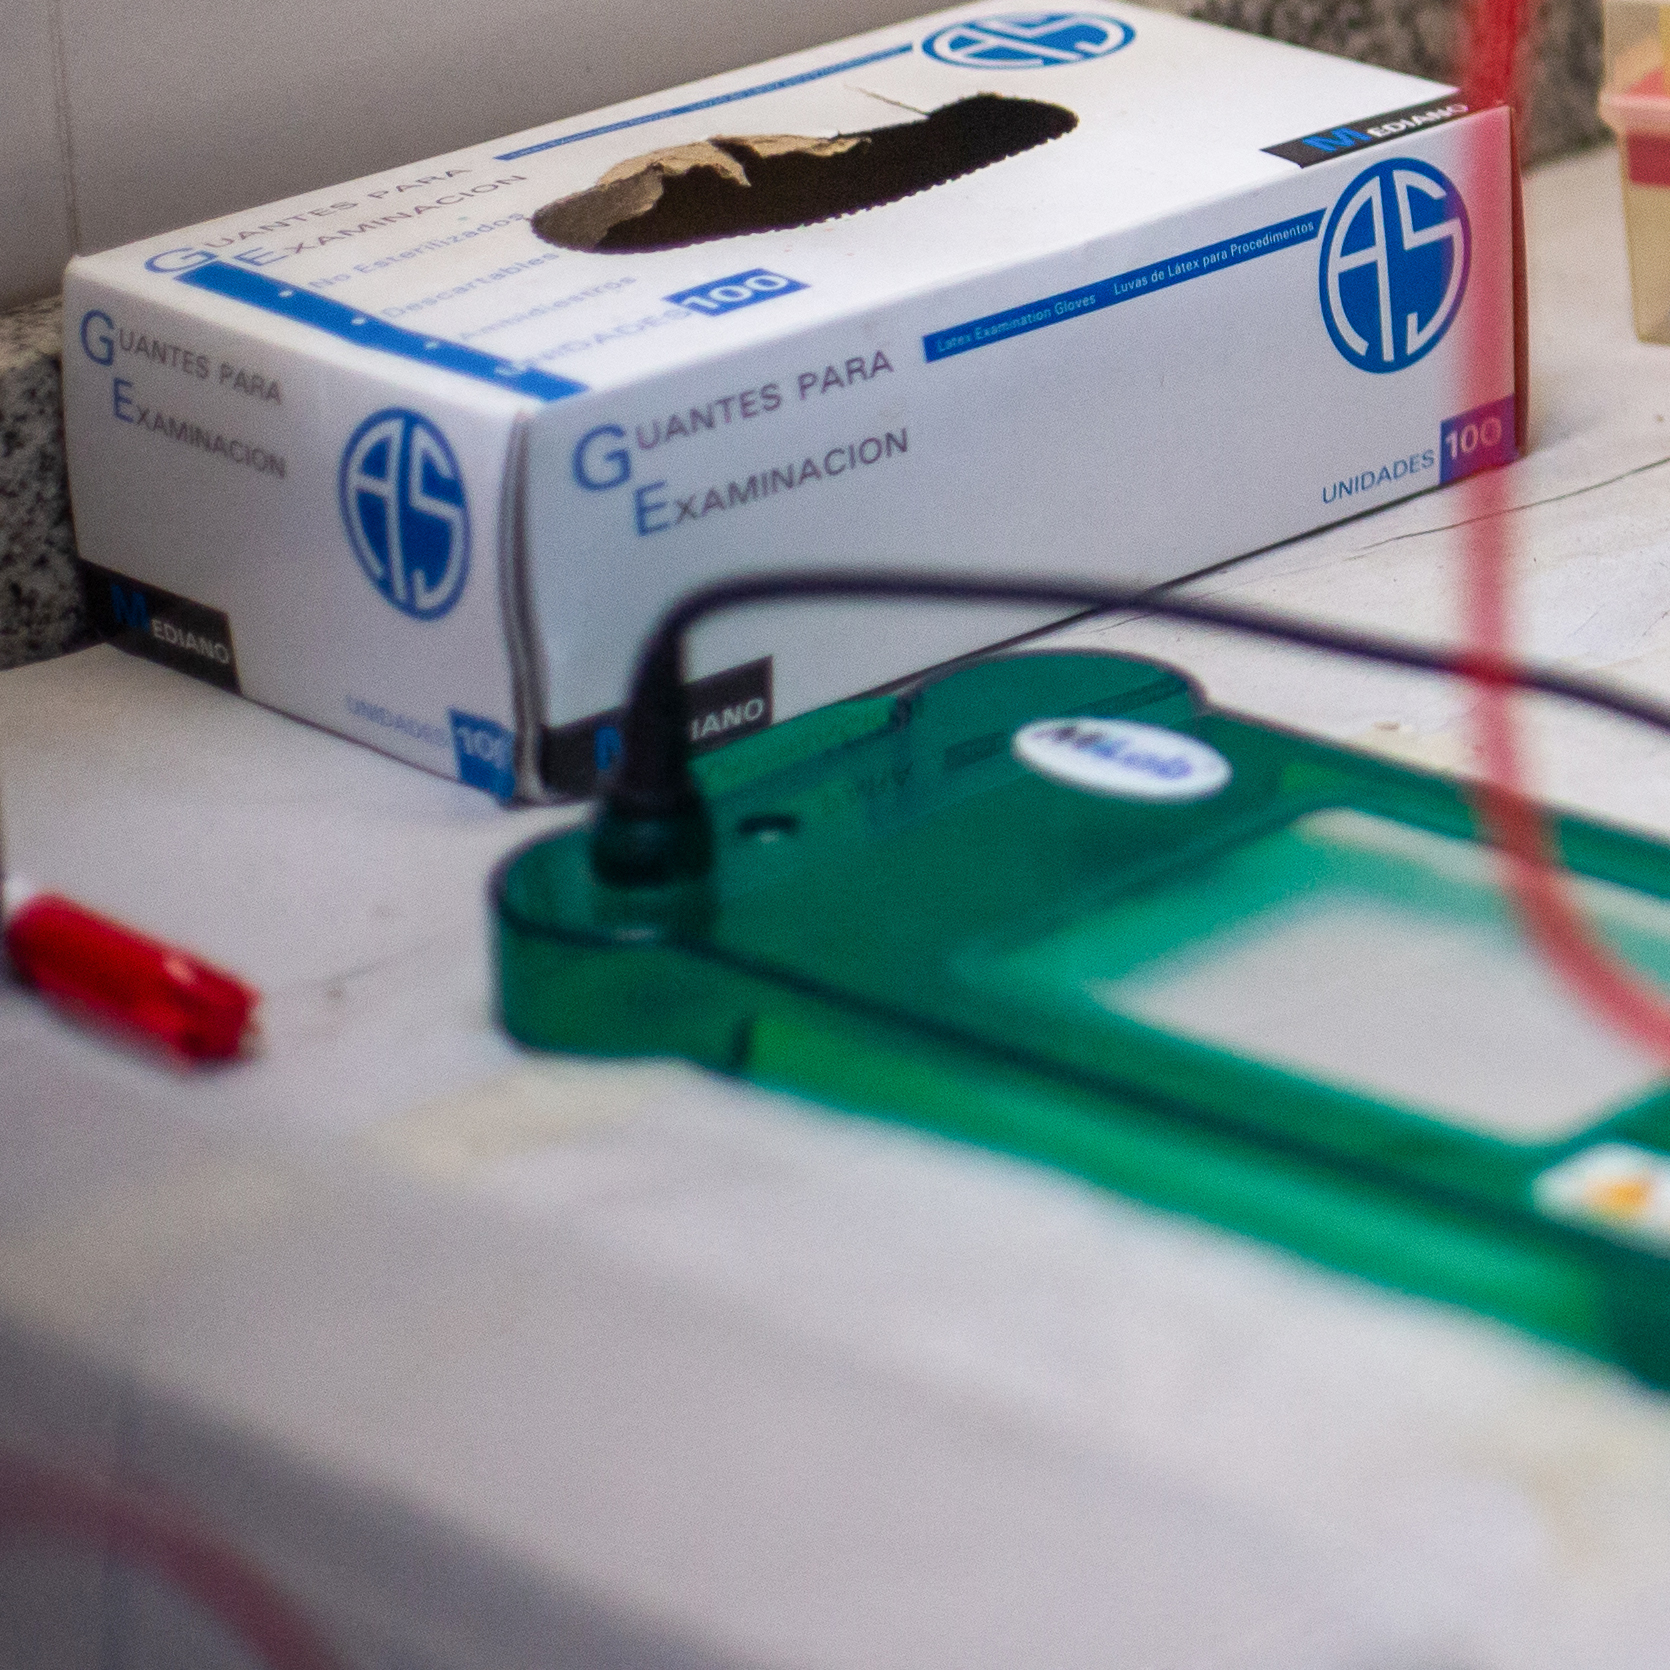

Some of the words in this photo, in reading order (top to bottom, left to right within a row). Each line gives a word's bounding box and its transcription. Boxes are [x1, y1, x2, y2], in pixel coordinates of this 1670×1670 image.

[931, 14, 1128, 68] AS
[1301, 102, 1469, 154] MEDIANO
[144, 200, 358, 274] GUANTES
[368, 168, 473, 200] PARA
[233, 173, 529, 268] EXAMINACION
[308, 271, 352, 290] No
[352, 211, 525, 275] Esterilizados
[1325, 167, 1466, 363] AS
[380, 252, 561, 319] Descartables
[493, 306, 694, 377] UNIDADES
[680, 274, 789, 309] 100
[937, 332, 972, 353] Latex
[974, 306, 1052, 340] Examination
[1054, 293, 1097, 317] Gloves
[1113, 276, 1149, 296] Luvas
[1151, 268, 1166, 283] de
[1167, 258, 1200, 279] Látex
[1202, 251, 1229, 270] para
[1230, 222, 1315, 257] Procedimentos
[80, 309, 211, 379] GUANTES
[218, 362, 282, 405] PARA
[112, 377, 287, 480] EXAMINACION
[572, 382, 783, 493] GUANTES
[797, 349, 895, 401] PARA
[1320, 449, 1436, 505] UNIDADES
[1444, 416, 1503, 461] 100
[346, 414, 466, 614] AS
[632, 428, 909, 537] EXAMINACION
[109, 583, 230, 665] MEDIANO
